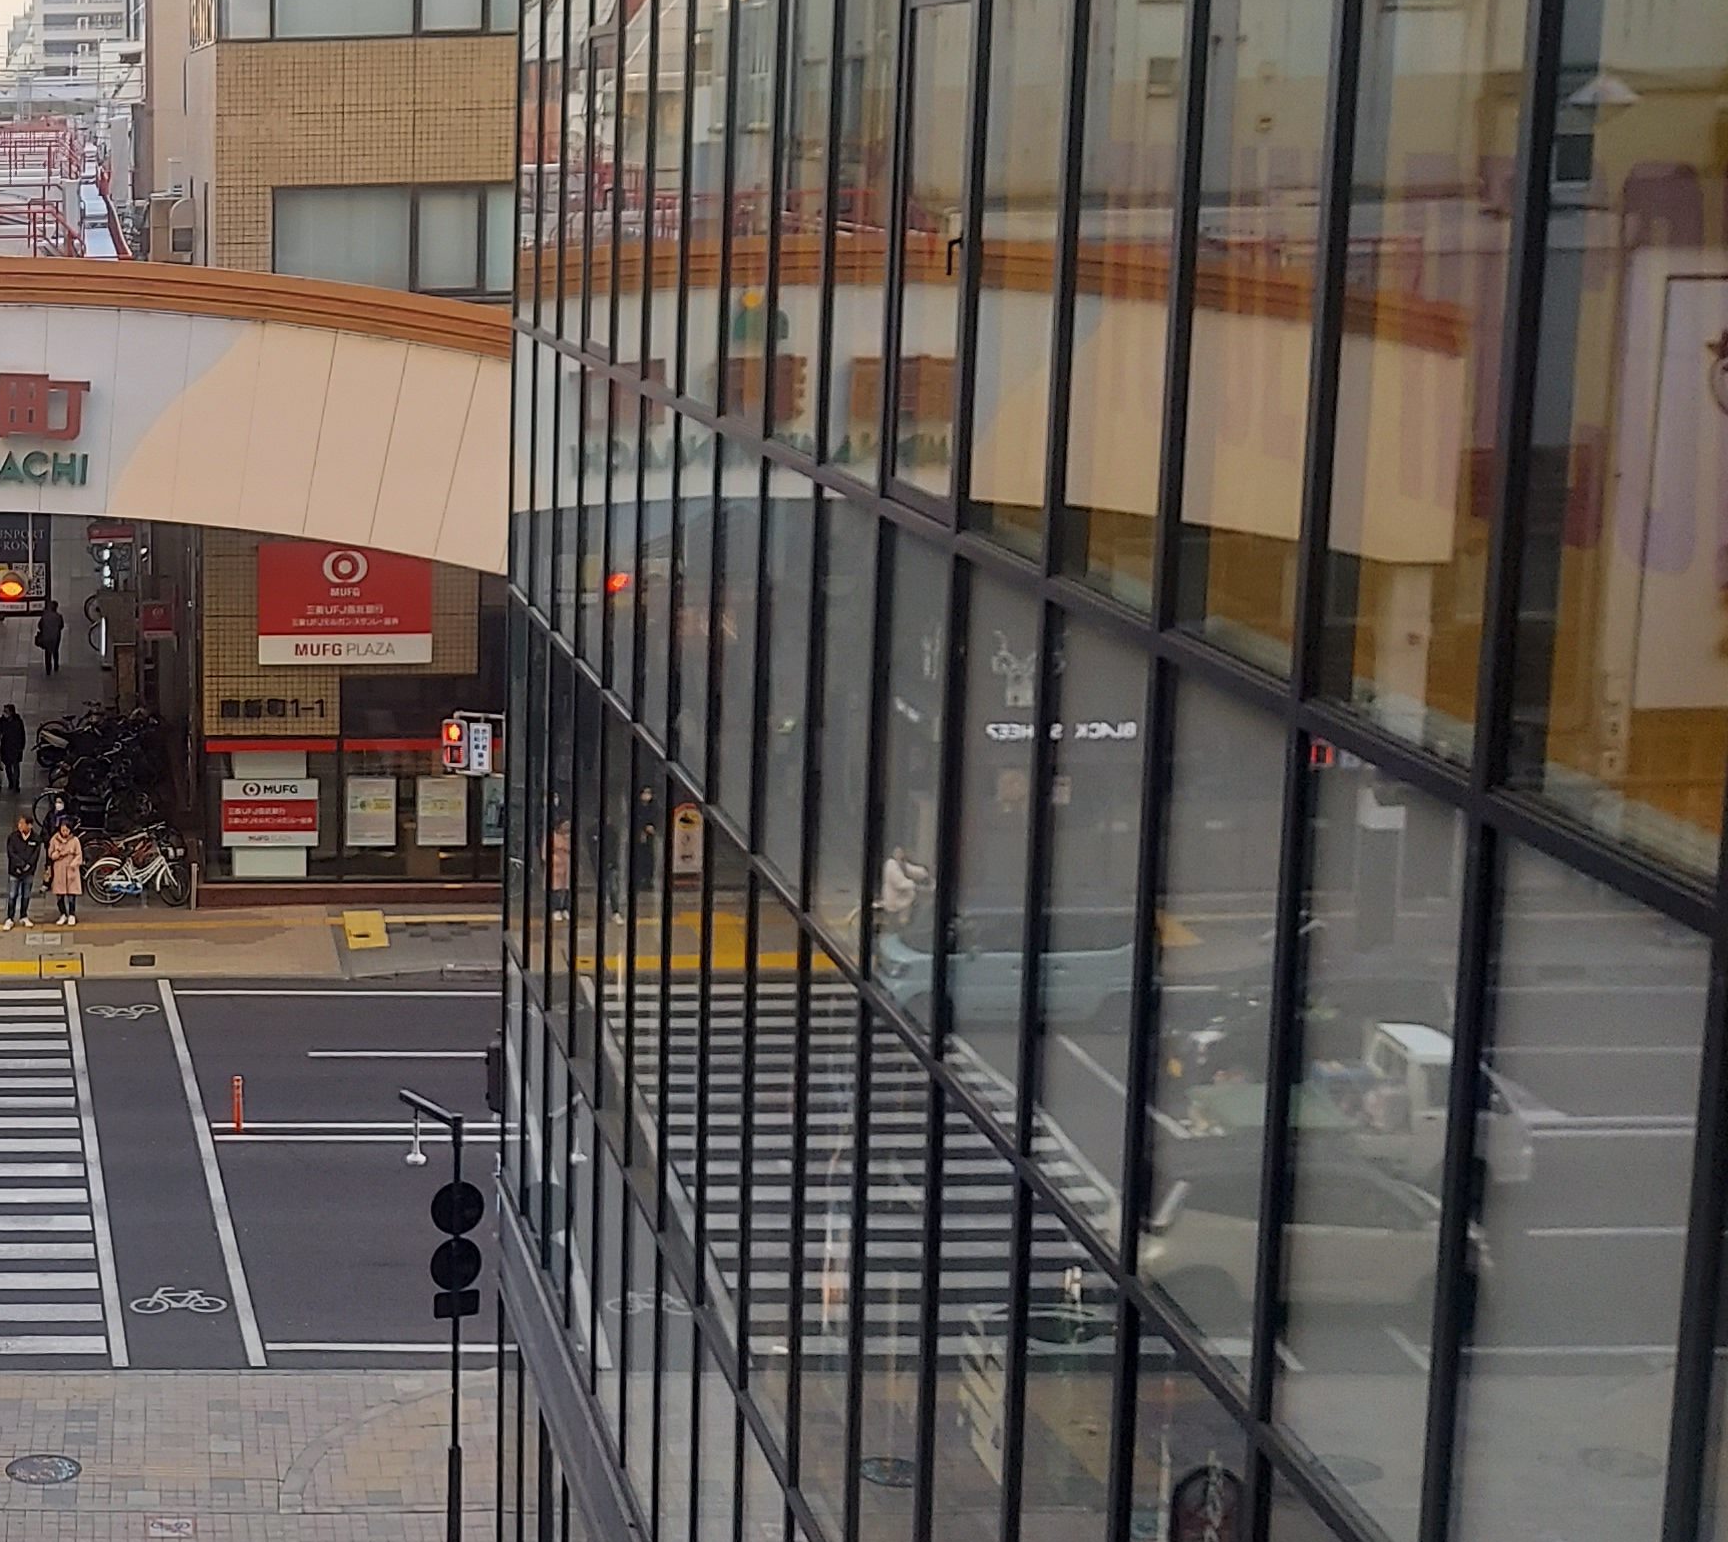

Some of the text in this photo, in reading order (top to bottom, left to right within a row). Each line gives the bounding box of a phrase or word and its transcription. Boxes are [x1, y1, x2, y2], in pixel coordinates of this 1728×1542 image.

[330, 587, 361, 597] MUFG
[294, 642, 396, 657] MUFG PLAZA
[263, 784, 298, 794] MUFG
